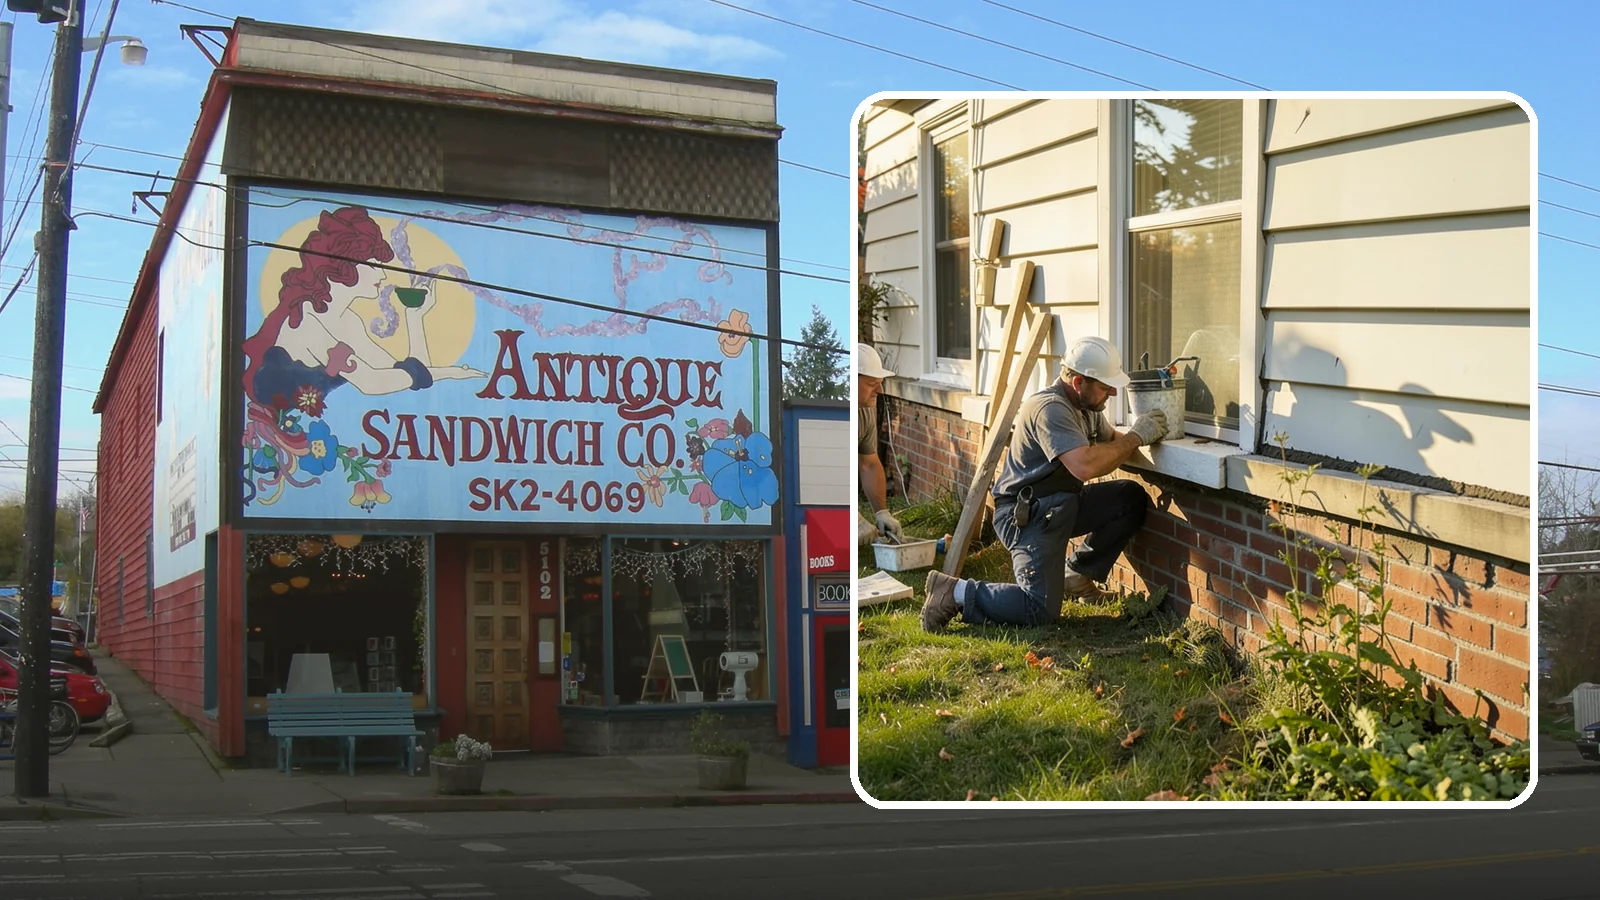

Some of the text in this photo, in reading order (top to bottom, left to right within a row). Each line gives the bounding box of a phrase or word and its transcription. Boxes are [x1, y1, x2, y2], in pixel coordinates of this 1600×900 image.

[475, 328, 723, 420] ANTIQUE
[361, 409, 686, 470] SANDWICH CO.
[468, 477, 645, 513] SK2-4069
[539, 541, 552, 600] 5102
[809, 555, 835, 569] BOOKS
